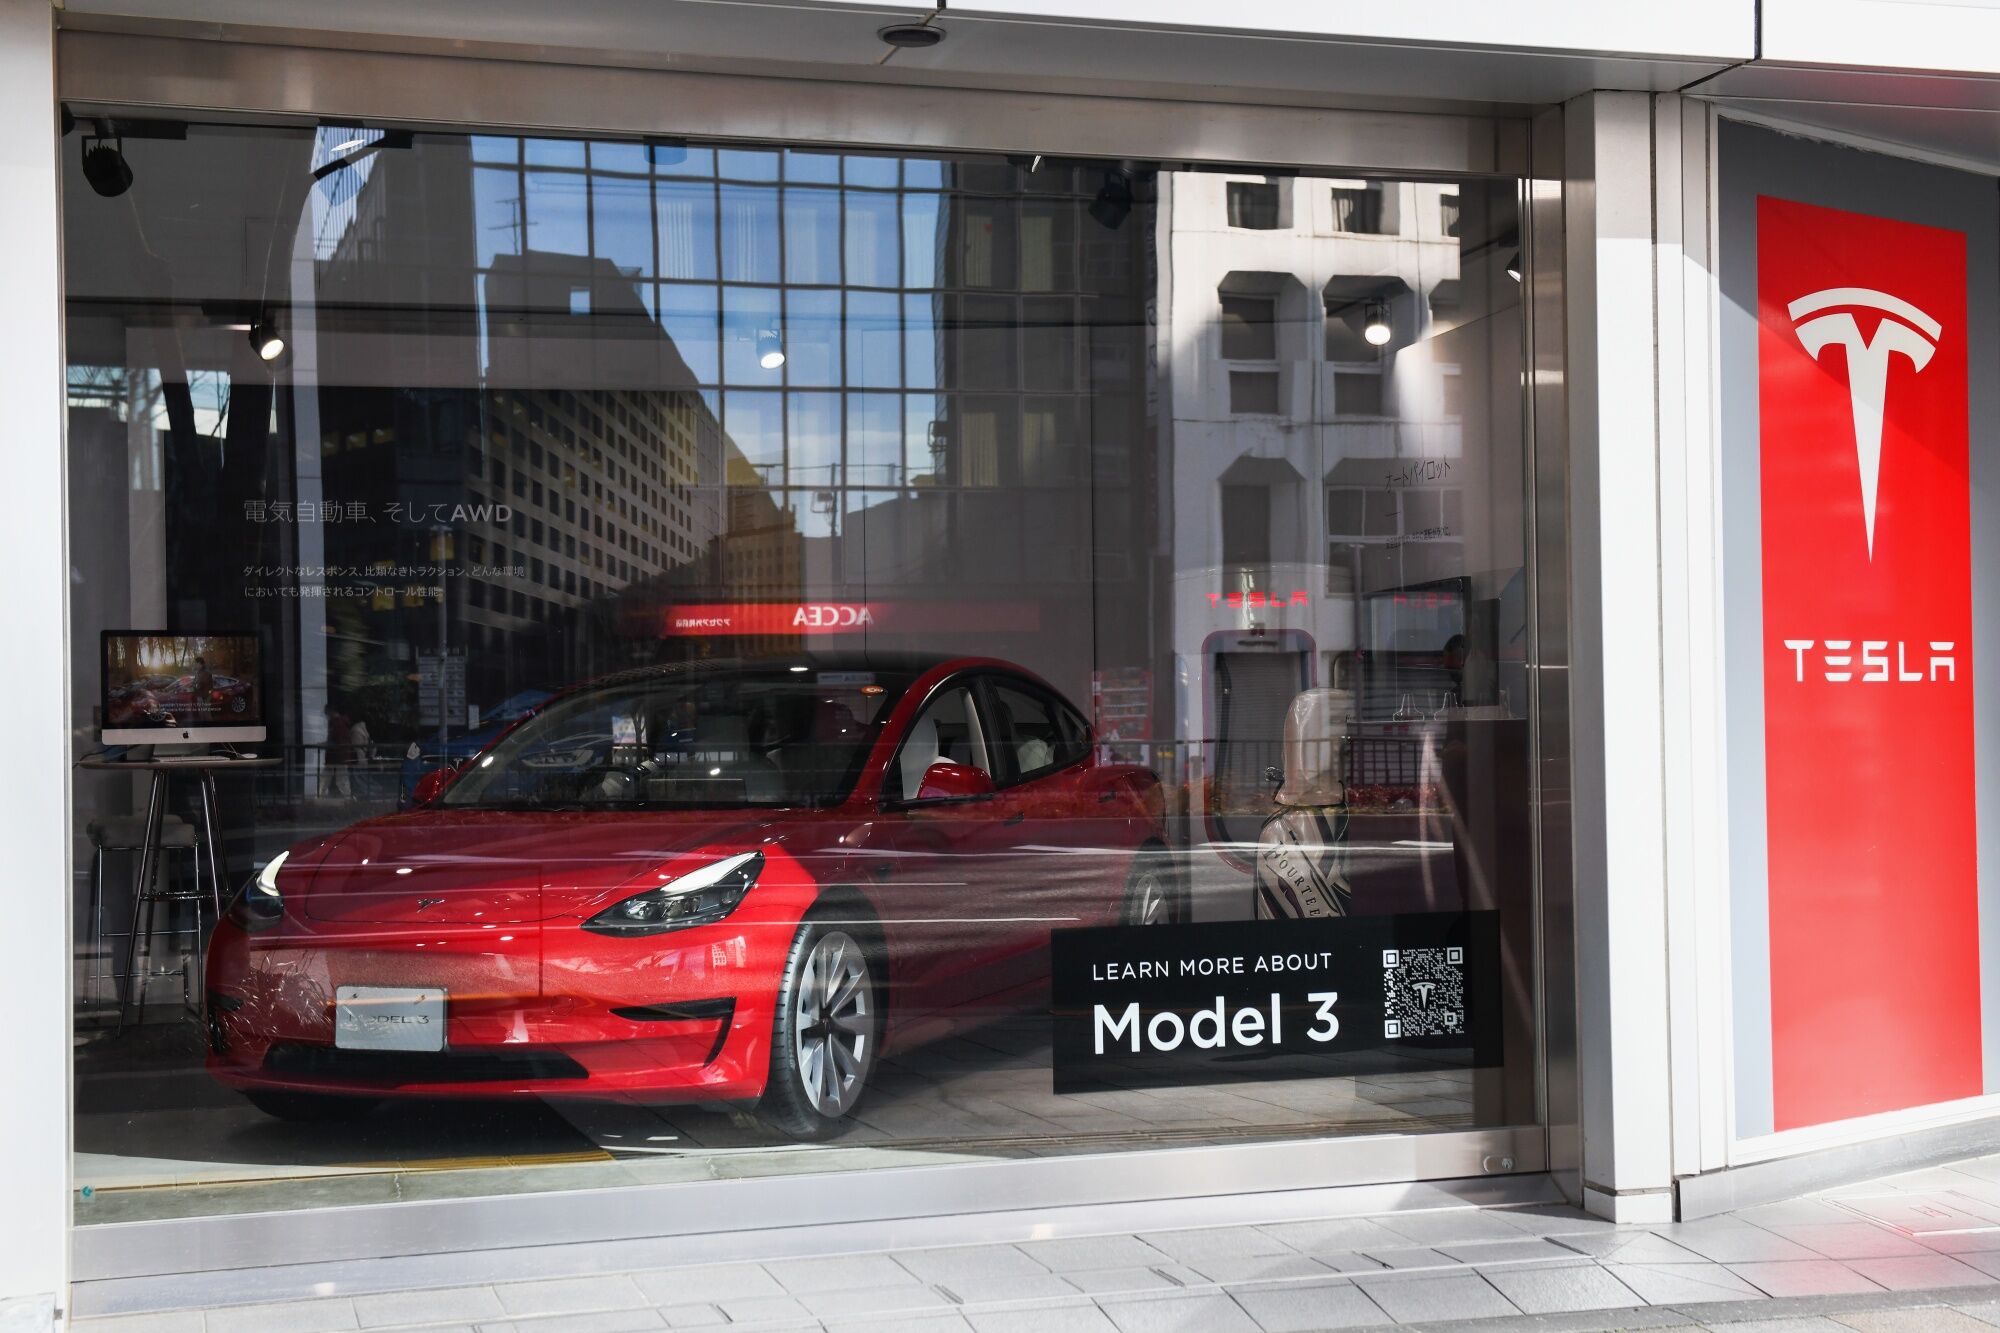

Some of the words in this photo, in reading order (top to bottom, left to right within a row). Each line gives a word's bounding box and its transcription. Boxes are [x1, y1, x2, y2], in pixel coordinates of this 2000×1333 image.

[1384, 456, 1451, 490] オートパイロット
[1205, 591, 1309, 609] TESLA
[1784, 640, 1955, 682] TESLA
[1263, 841, 1324, 918] FOURTEE
[1093, 960, 1169, 981] LEARN
[1180, 957, 1245, 976] MORE
[1254, 953, 1332, 972] ABOUT
[417, 1014, 430, 1025] 3
[1093, 992, 1282, 1055] Model
[1306, 991, 1340, 1042] 3
